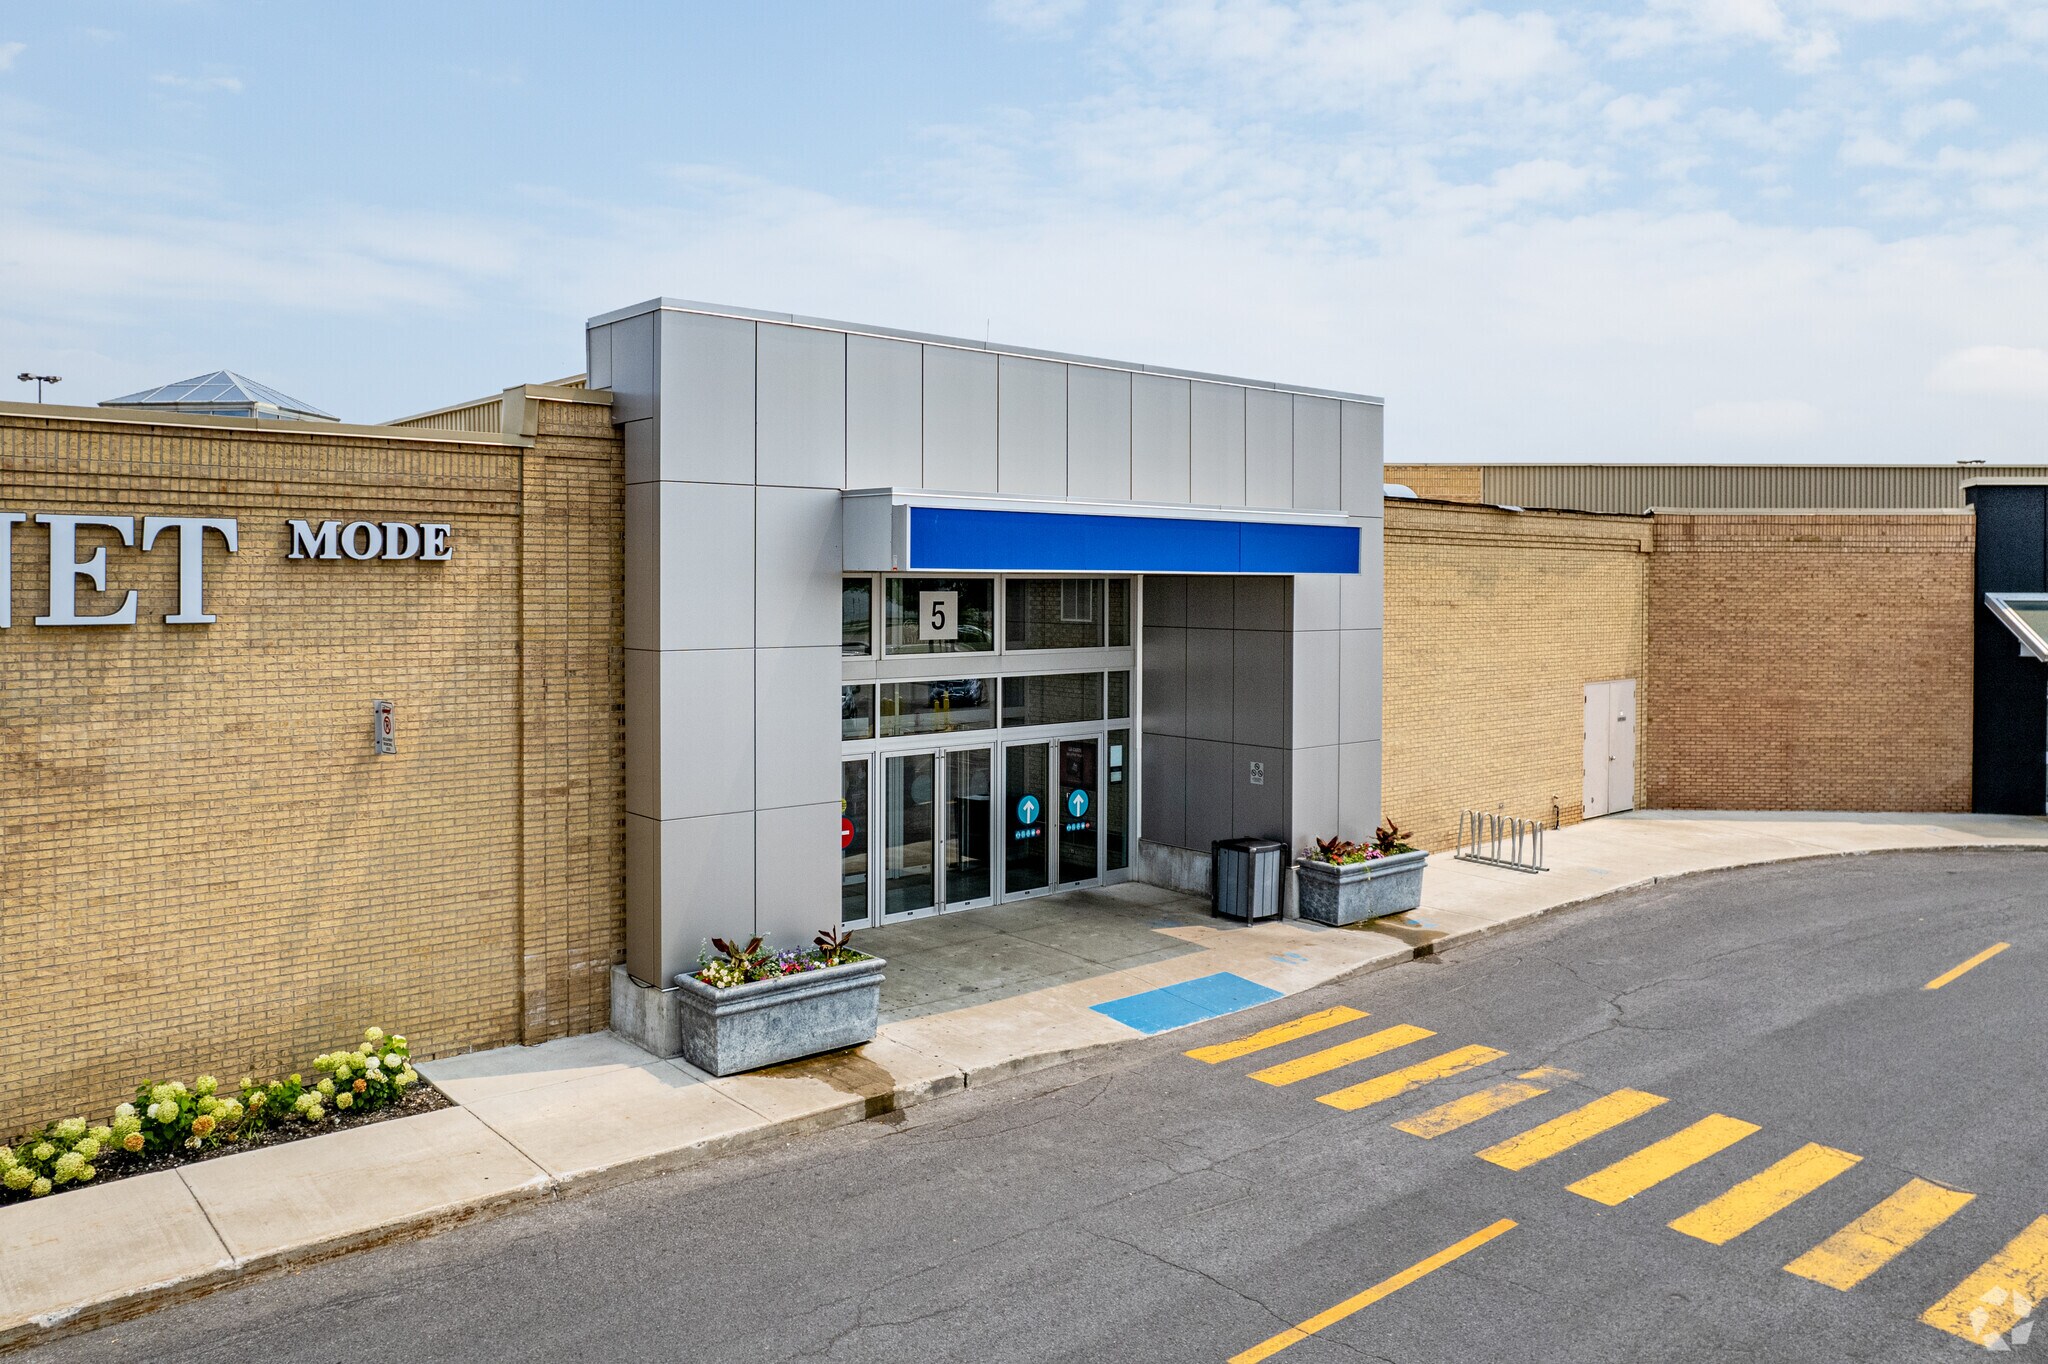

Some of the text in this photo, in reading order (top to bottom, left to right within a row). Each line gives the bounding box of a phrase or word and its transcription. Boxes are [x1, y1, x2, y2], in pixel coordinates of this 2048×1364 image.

[286, 519, 453, 561] MODE
[0, 512, 238, 628] ET
[931, 600, 946, 631] 5
